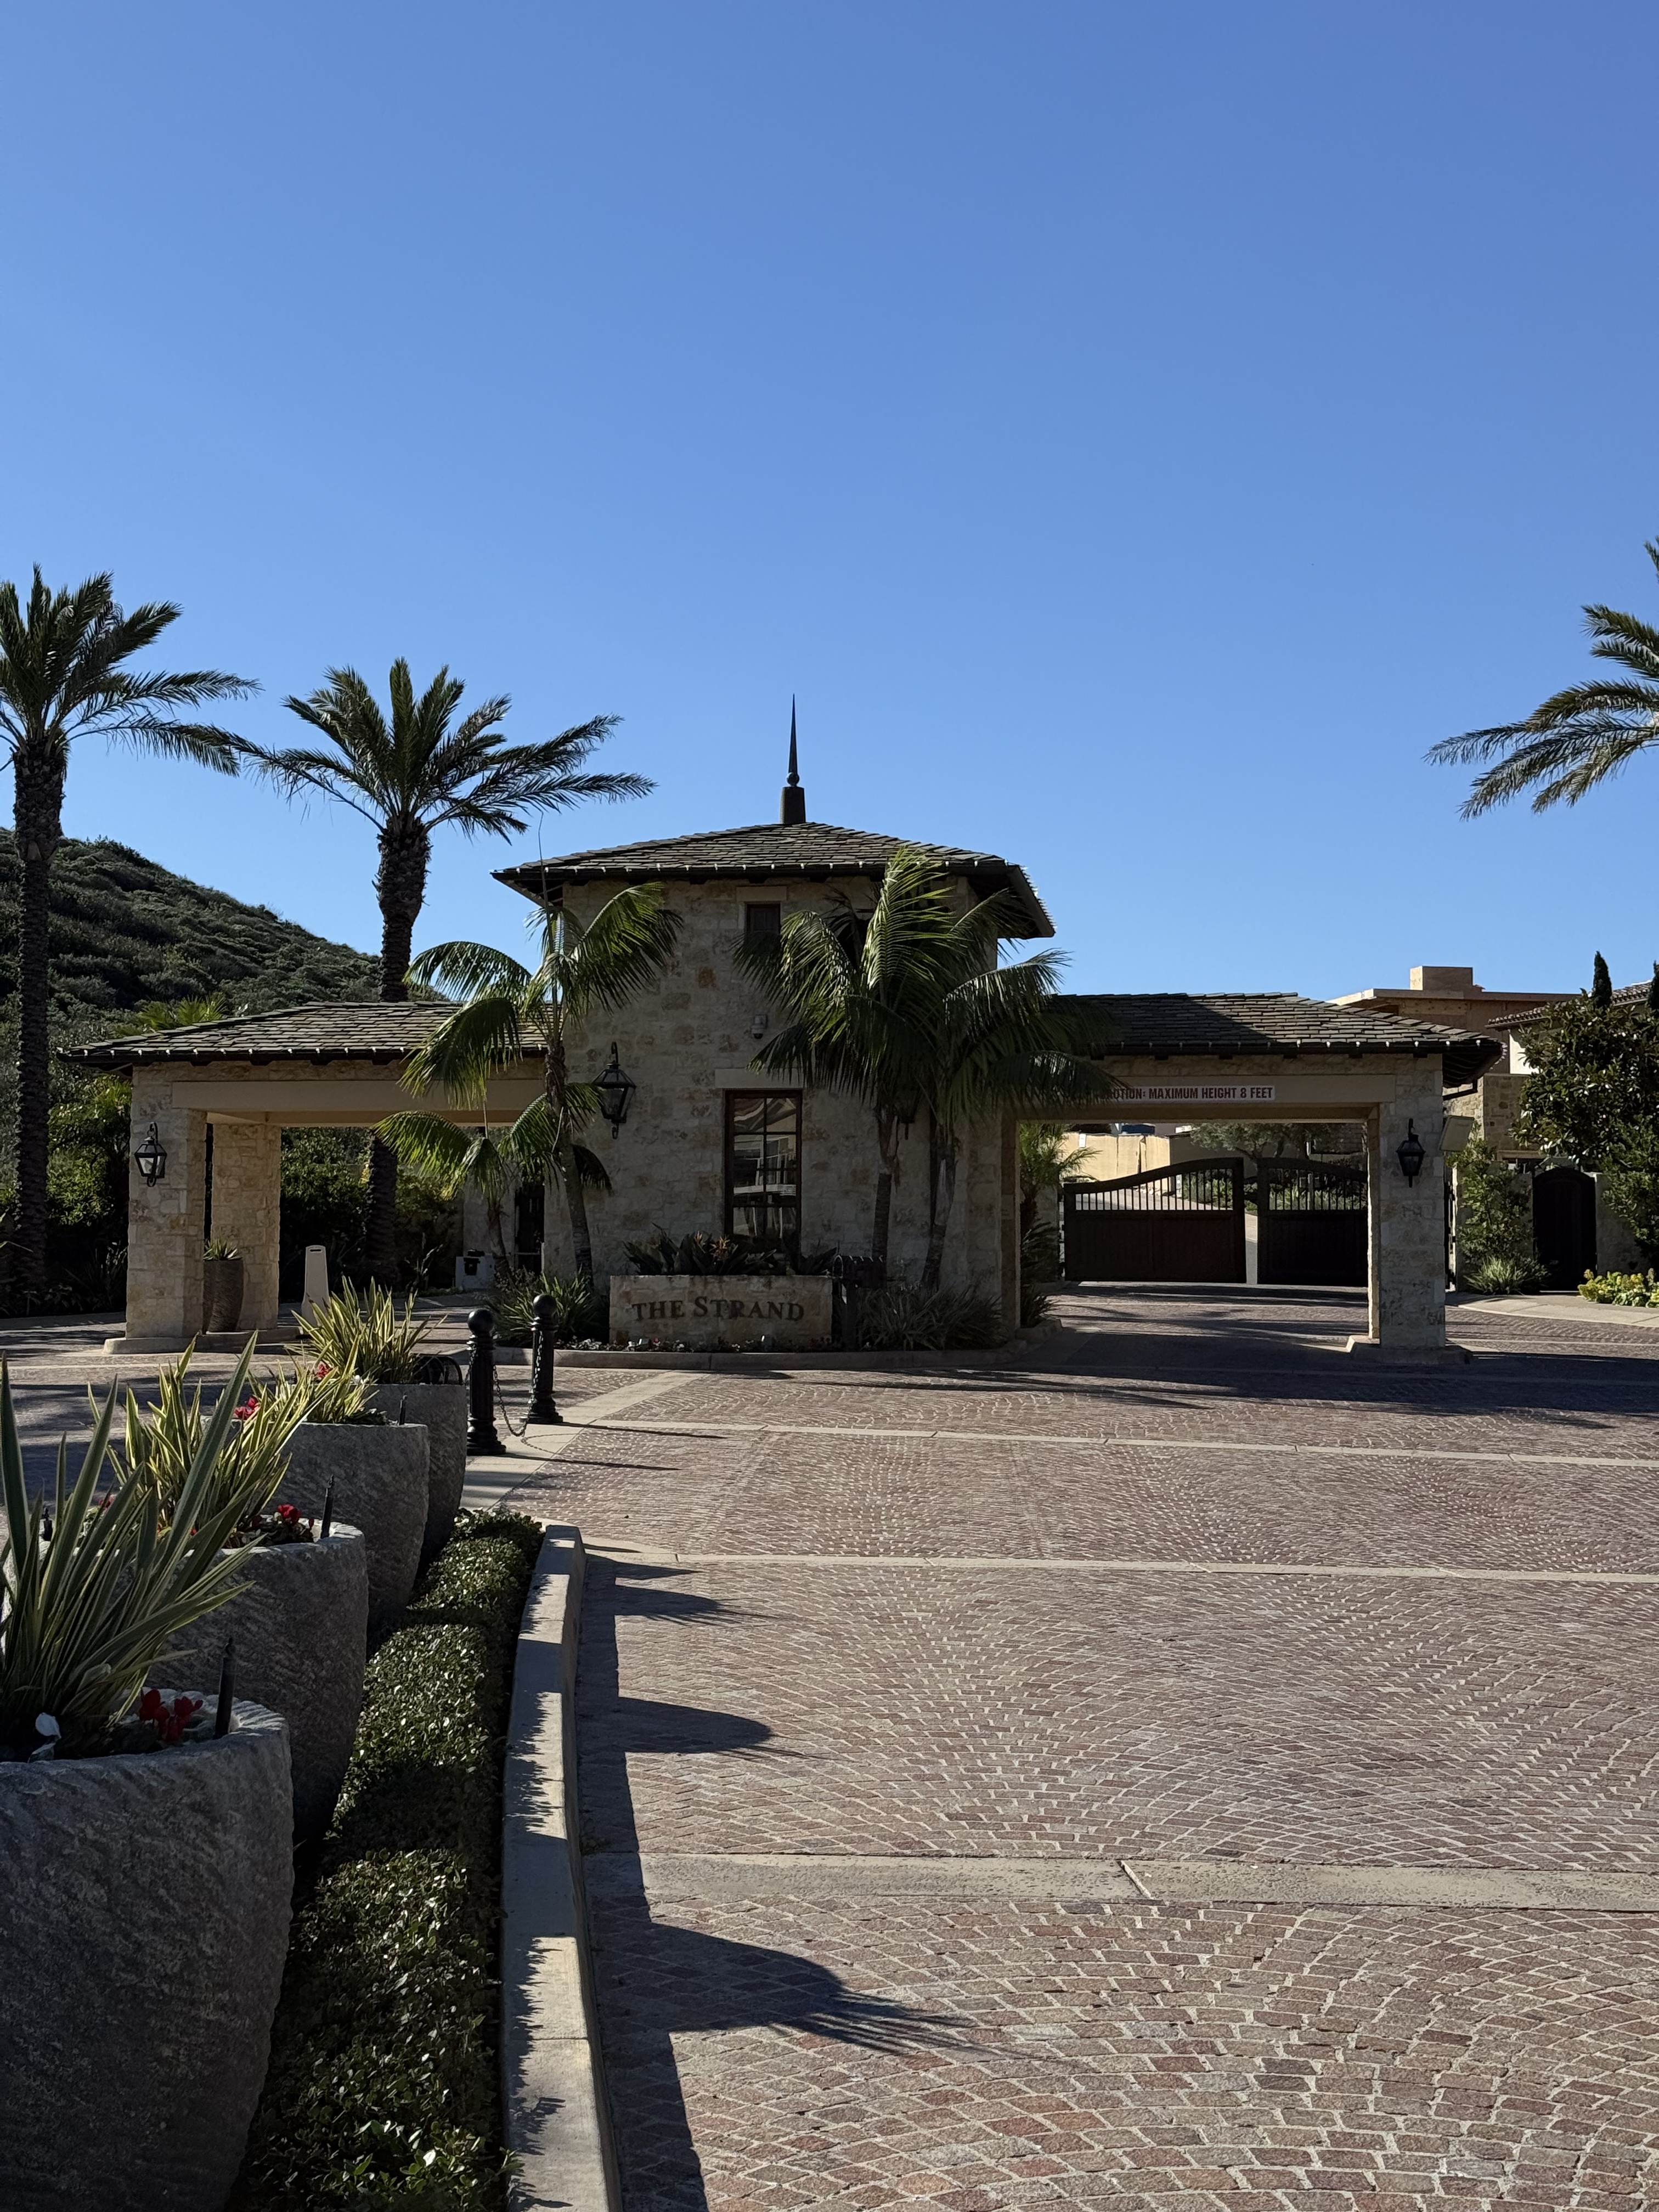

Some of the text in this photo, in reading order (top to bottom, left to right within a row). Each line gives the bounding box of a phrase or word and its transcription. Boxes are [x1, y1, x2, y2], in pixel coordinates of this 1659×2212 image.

[1106, 1087, 1273, 1099] UTION: MAXIMUM HEIGHT 8 FEET
[631, 1296, 805, 1322] THE STRAND
